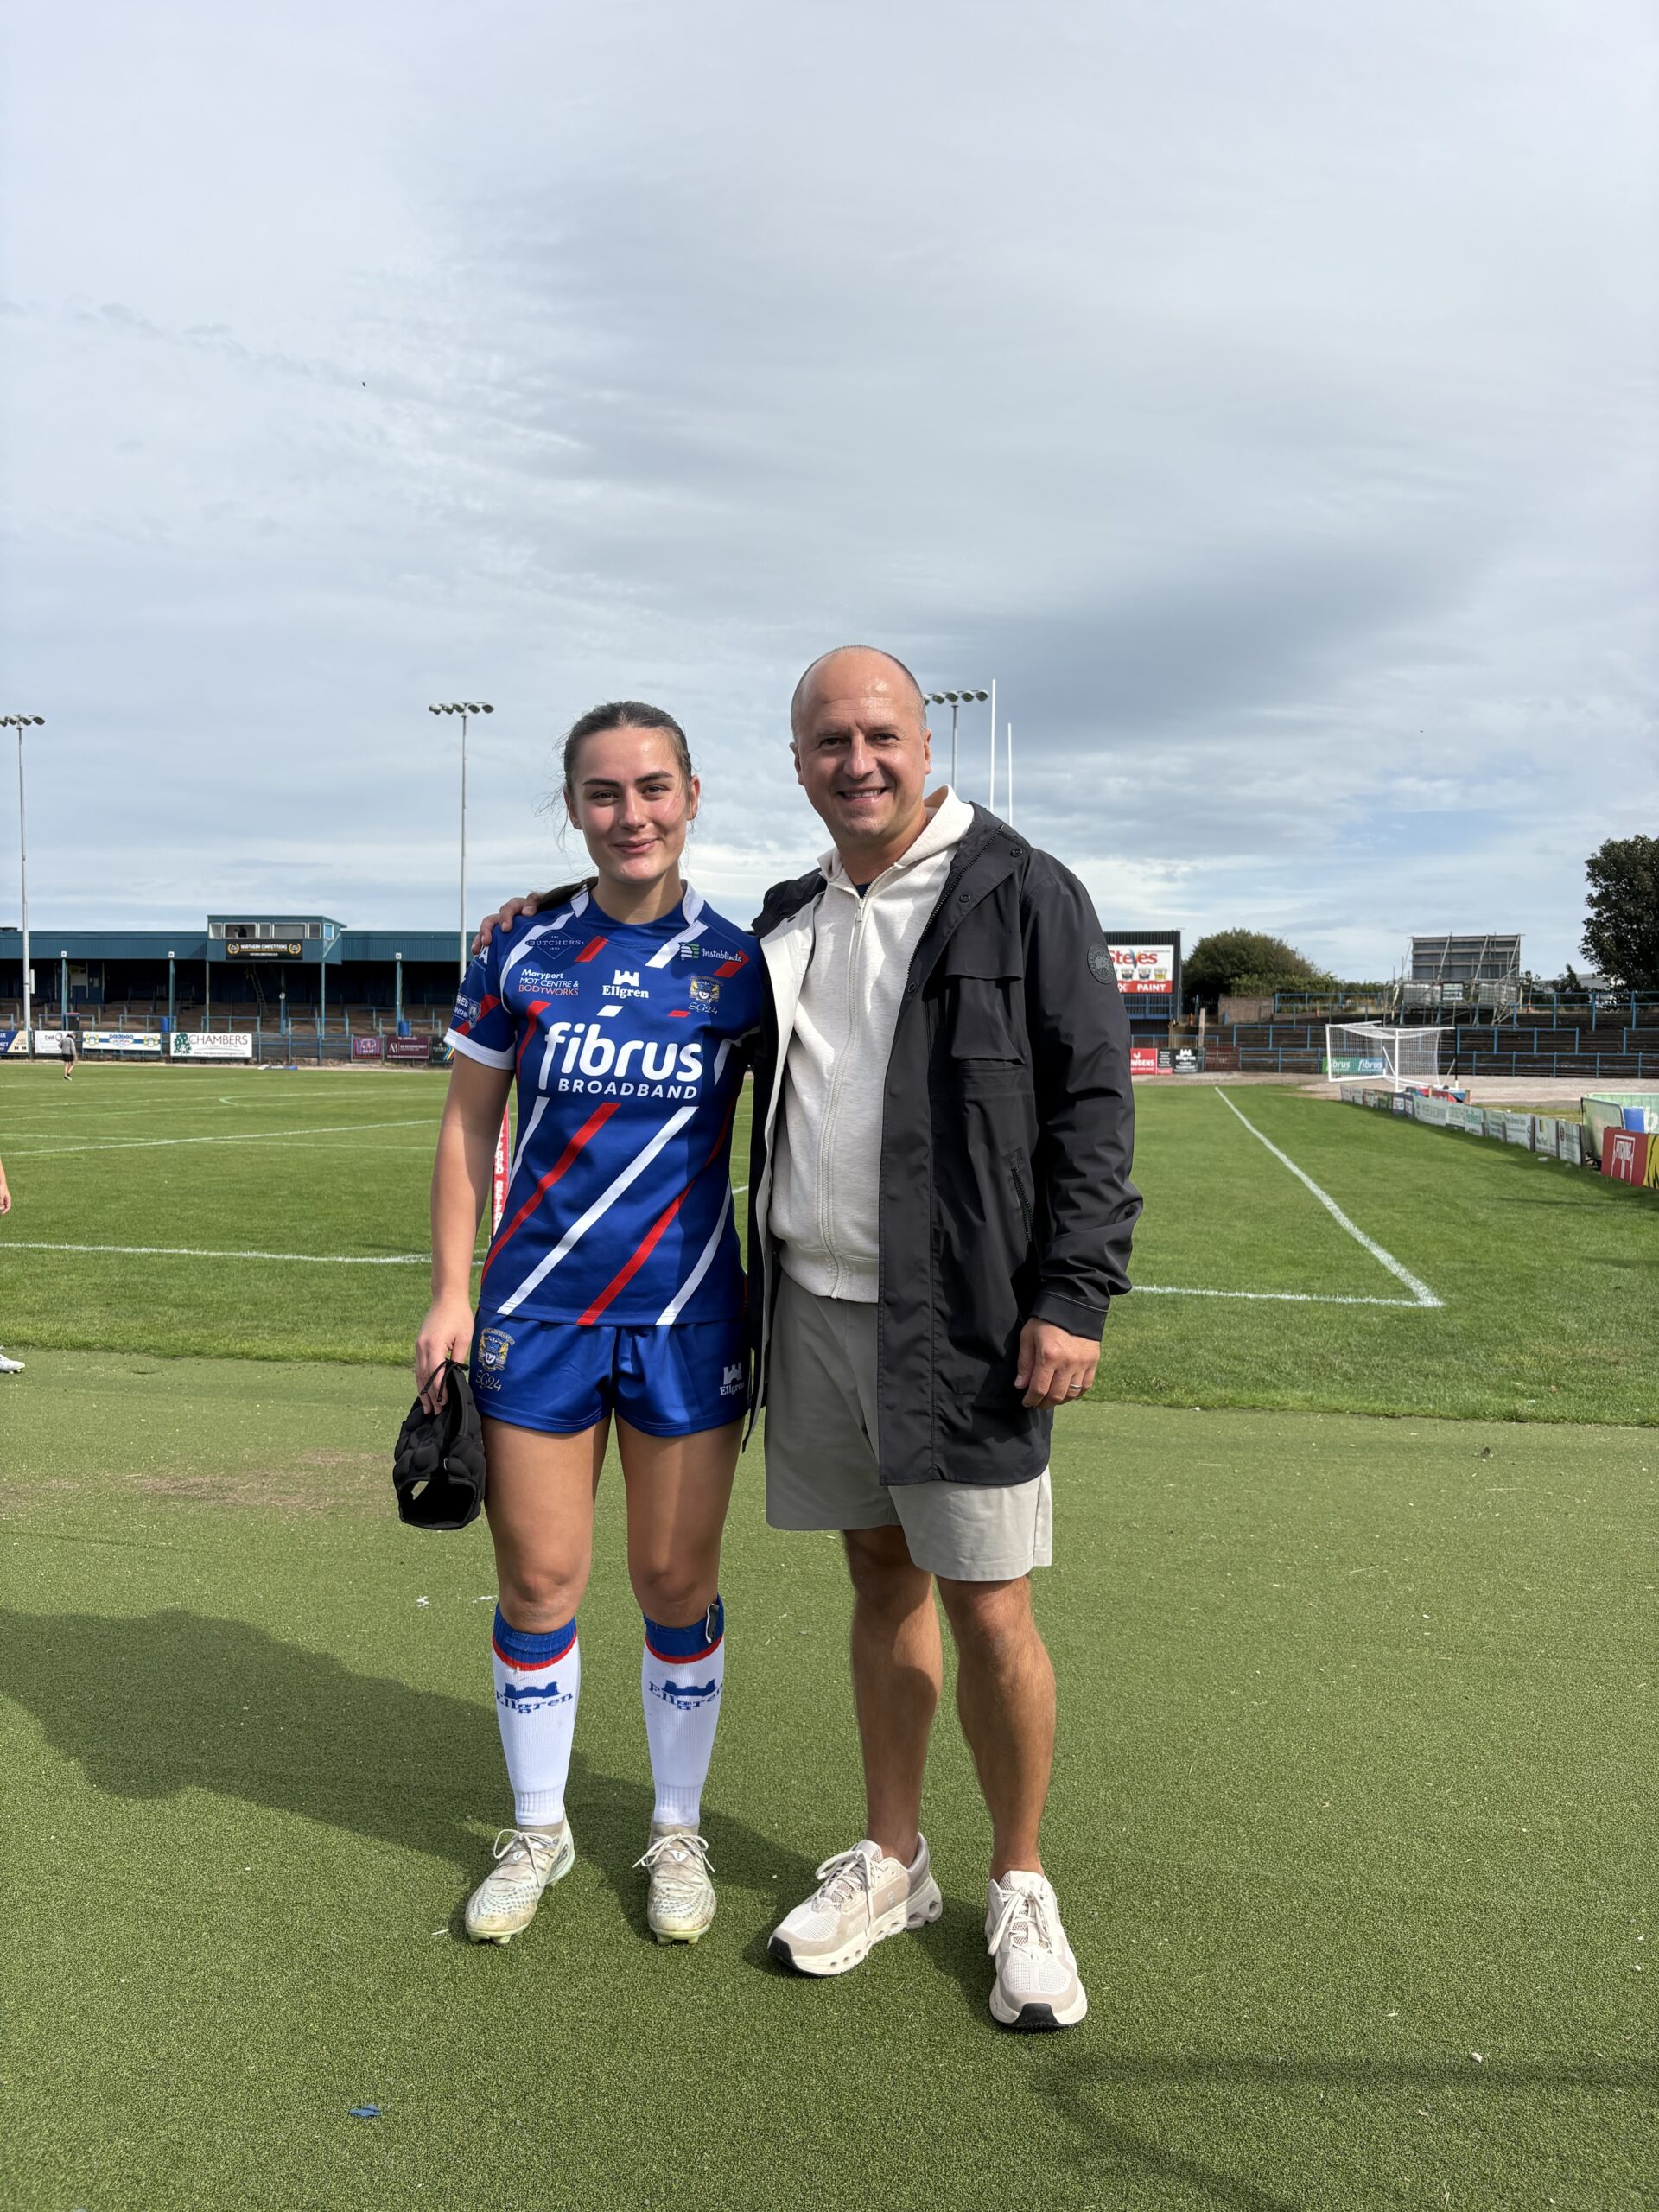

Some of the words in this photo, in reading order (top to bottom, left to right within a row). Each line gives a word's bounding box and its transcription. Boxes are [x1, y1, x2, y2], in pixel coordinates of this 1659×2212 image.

[701, 948, 742, 962] Instablinds
[521, 969, 563, 981] Maryport
[518, 984, 579, 995] BODYWORKS
[540, 979, 572, 988] CENTRE
[1136, 983, 1166, 992] PAINT
[601, 985, 650, 999] Ellgren
[188, 1034, 248, 1045] CHAMBERS
[538, 1021, 702, 1090] fibrus
[557, 1078, 698, 1099] BROADBAND
[496, 1690, 573, 1714] Ellgren
[649, 1681, 723, 1711] Ellgren
